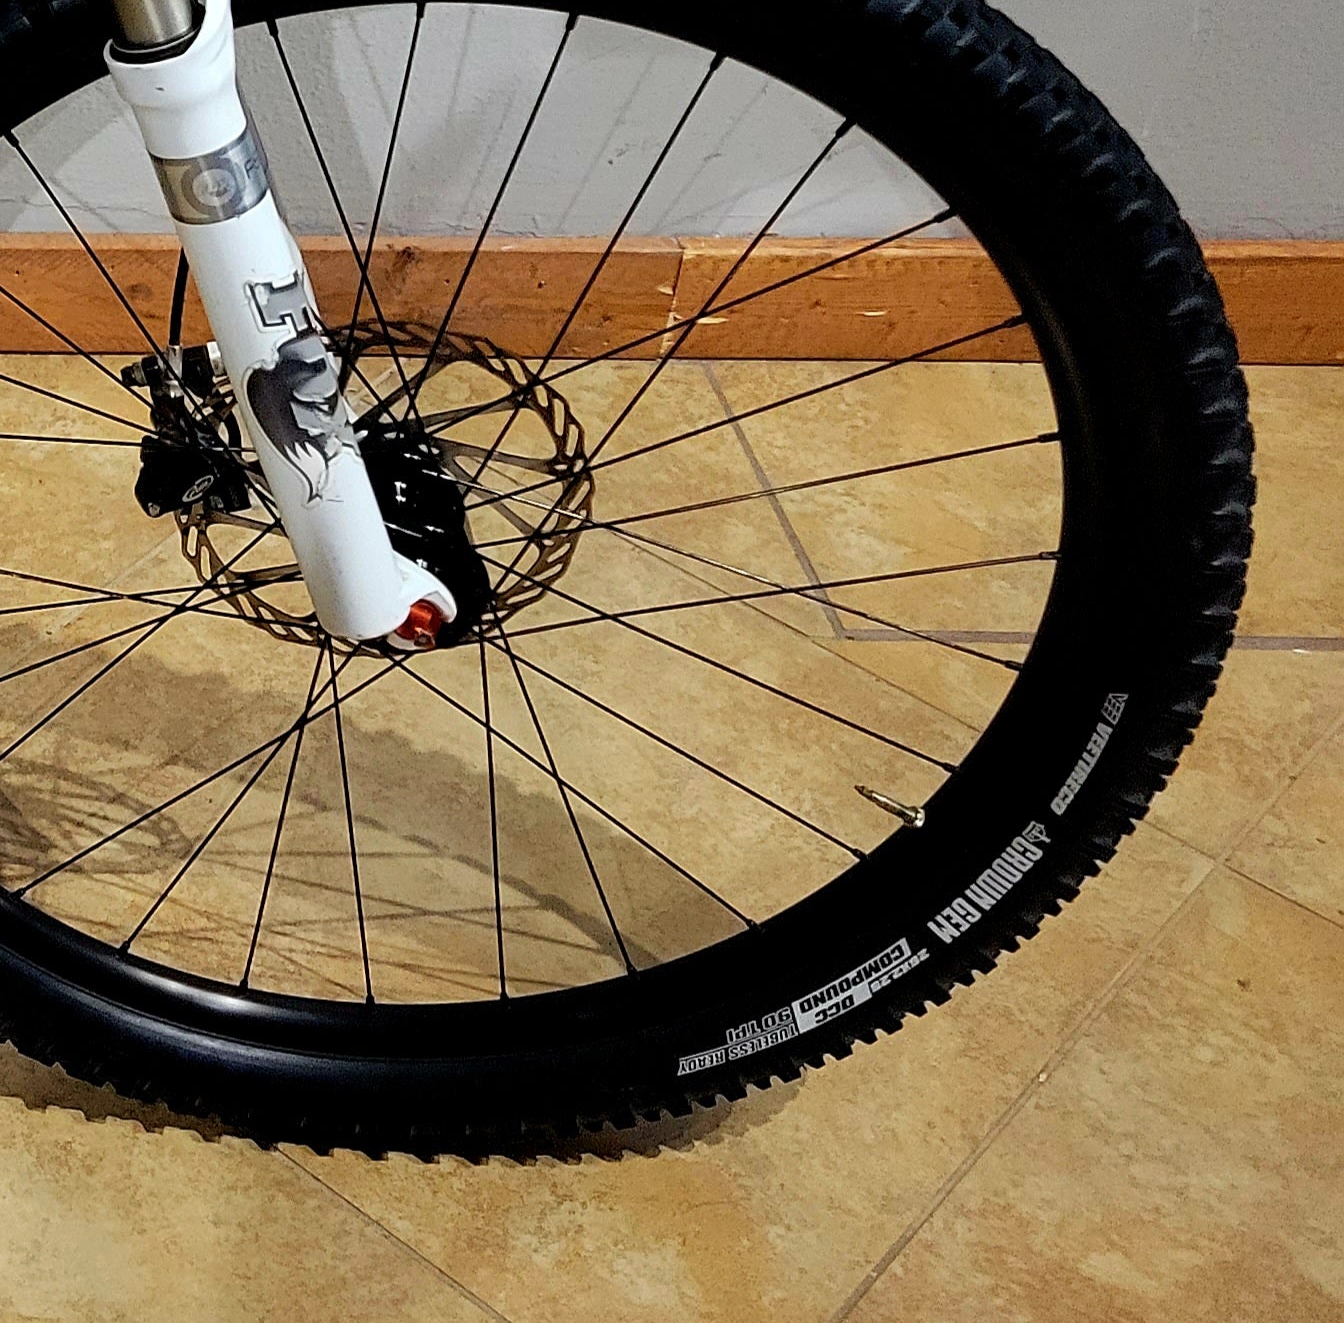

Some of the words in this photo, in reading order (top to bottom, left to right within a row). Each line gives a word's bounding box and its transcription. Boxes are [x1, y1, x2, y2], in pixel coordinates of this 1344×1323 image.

[964, 836, 1043, 911] CROWN
[927, 897, 982, 944] GEM
[799, 943, 905, 1013] COMPOUND
[726, 1019, 761, 1044] TPI
[729, 1023, 798, 1060] TUBELESS
[677, 1048, 726, 1076] READY
